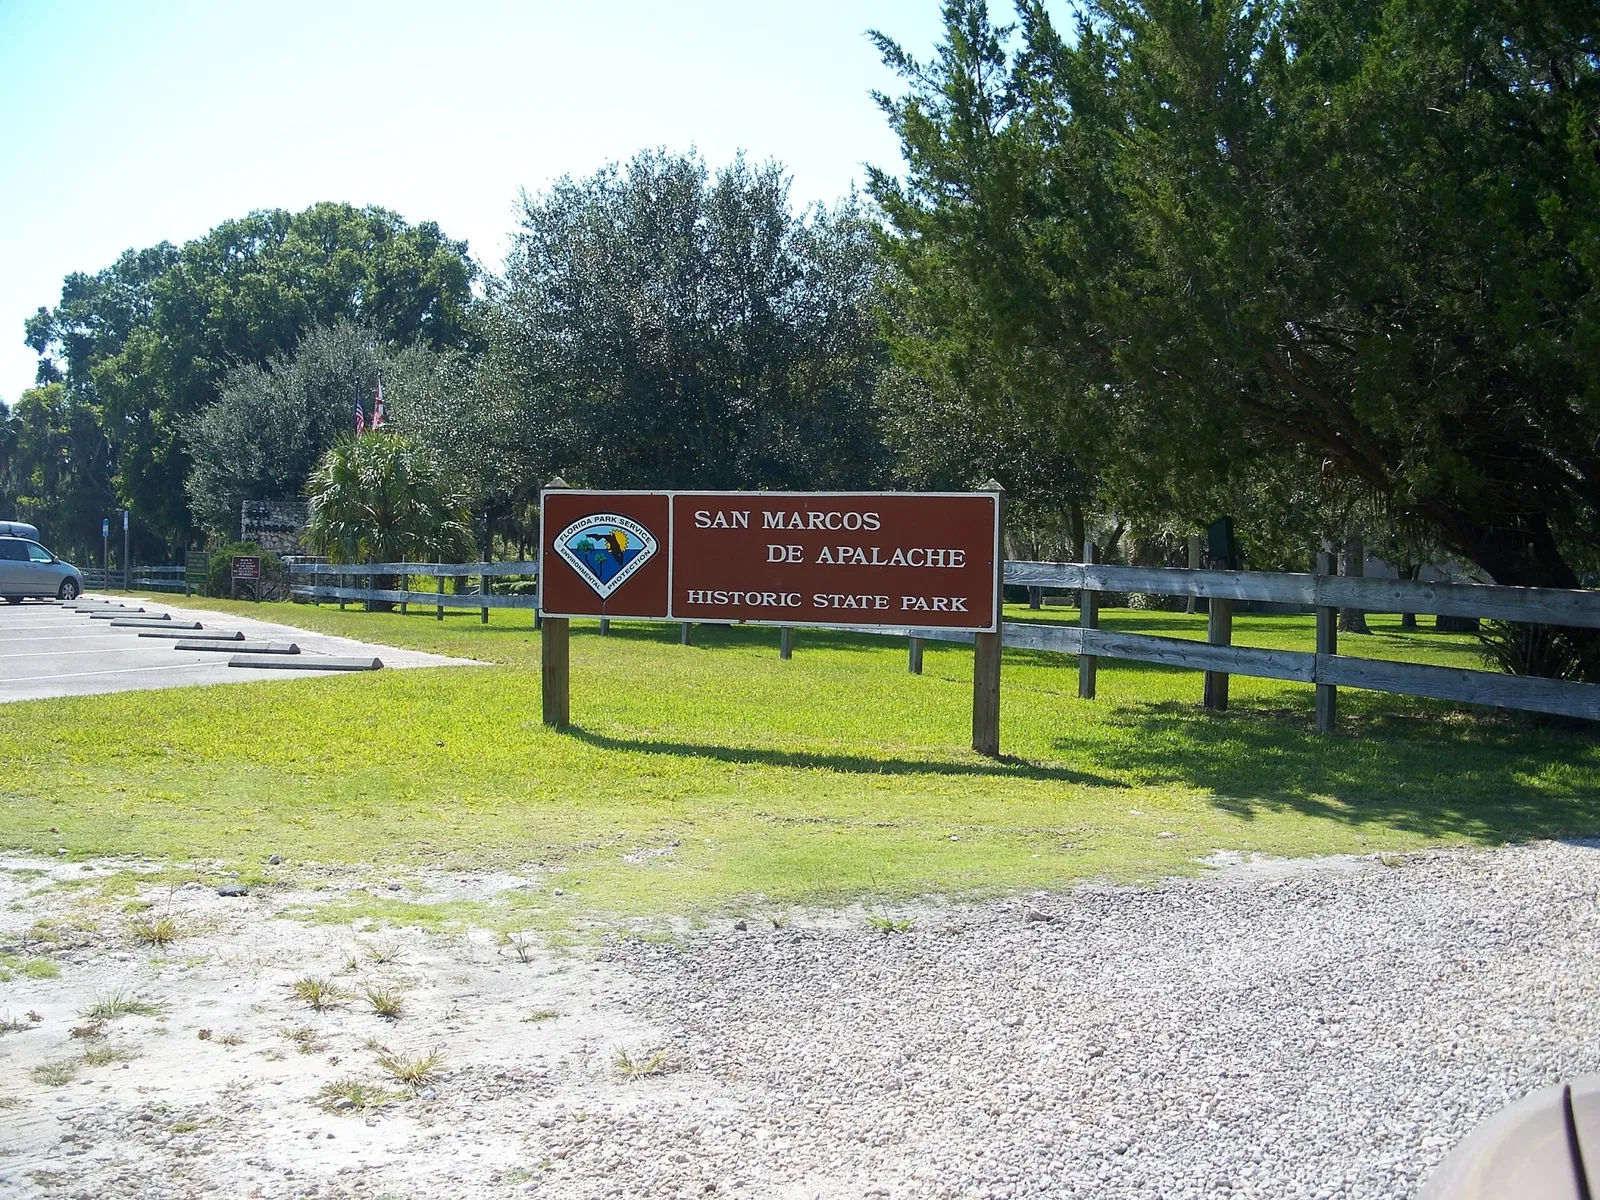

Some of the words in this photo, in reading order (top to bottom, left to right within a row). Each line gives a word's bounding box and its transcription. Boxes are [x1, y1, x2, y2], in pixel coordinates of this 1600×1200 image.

[559, 518, 593, 542] FLORIDA
[594, 515, 617, 523] PARK
[619, 518, 652, 544] SERVICE
[694, 510, 751, 529] SAN
[762, 511, 881, 530] MARCOS
[766, 544, 804, 563] DE
[815, 546, 966, 567] APALACHE
[560, 548, 601, 590] ENVIRONMENTAL
[607, 549, 651, 590] PROTECTION
[687, 589, 802, 607] HISTORIC
[812, 593, 890, 610] STATE
[900, 596, 969, 612] PARK
